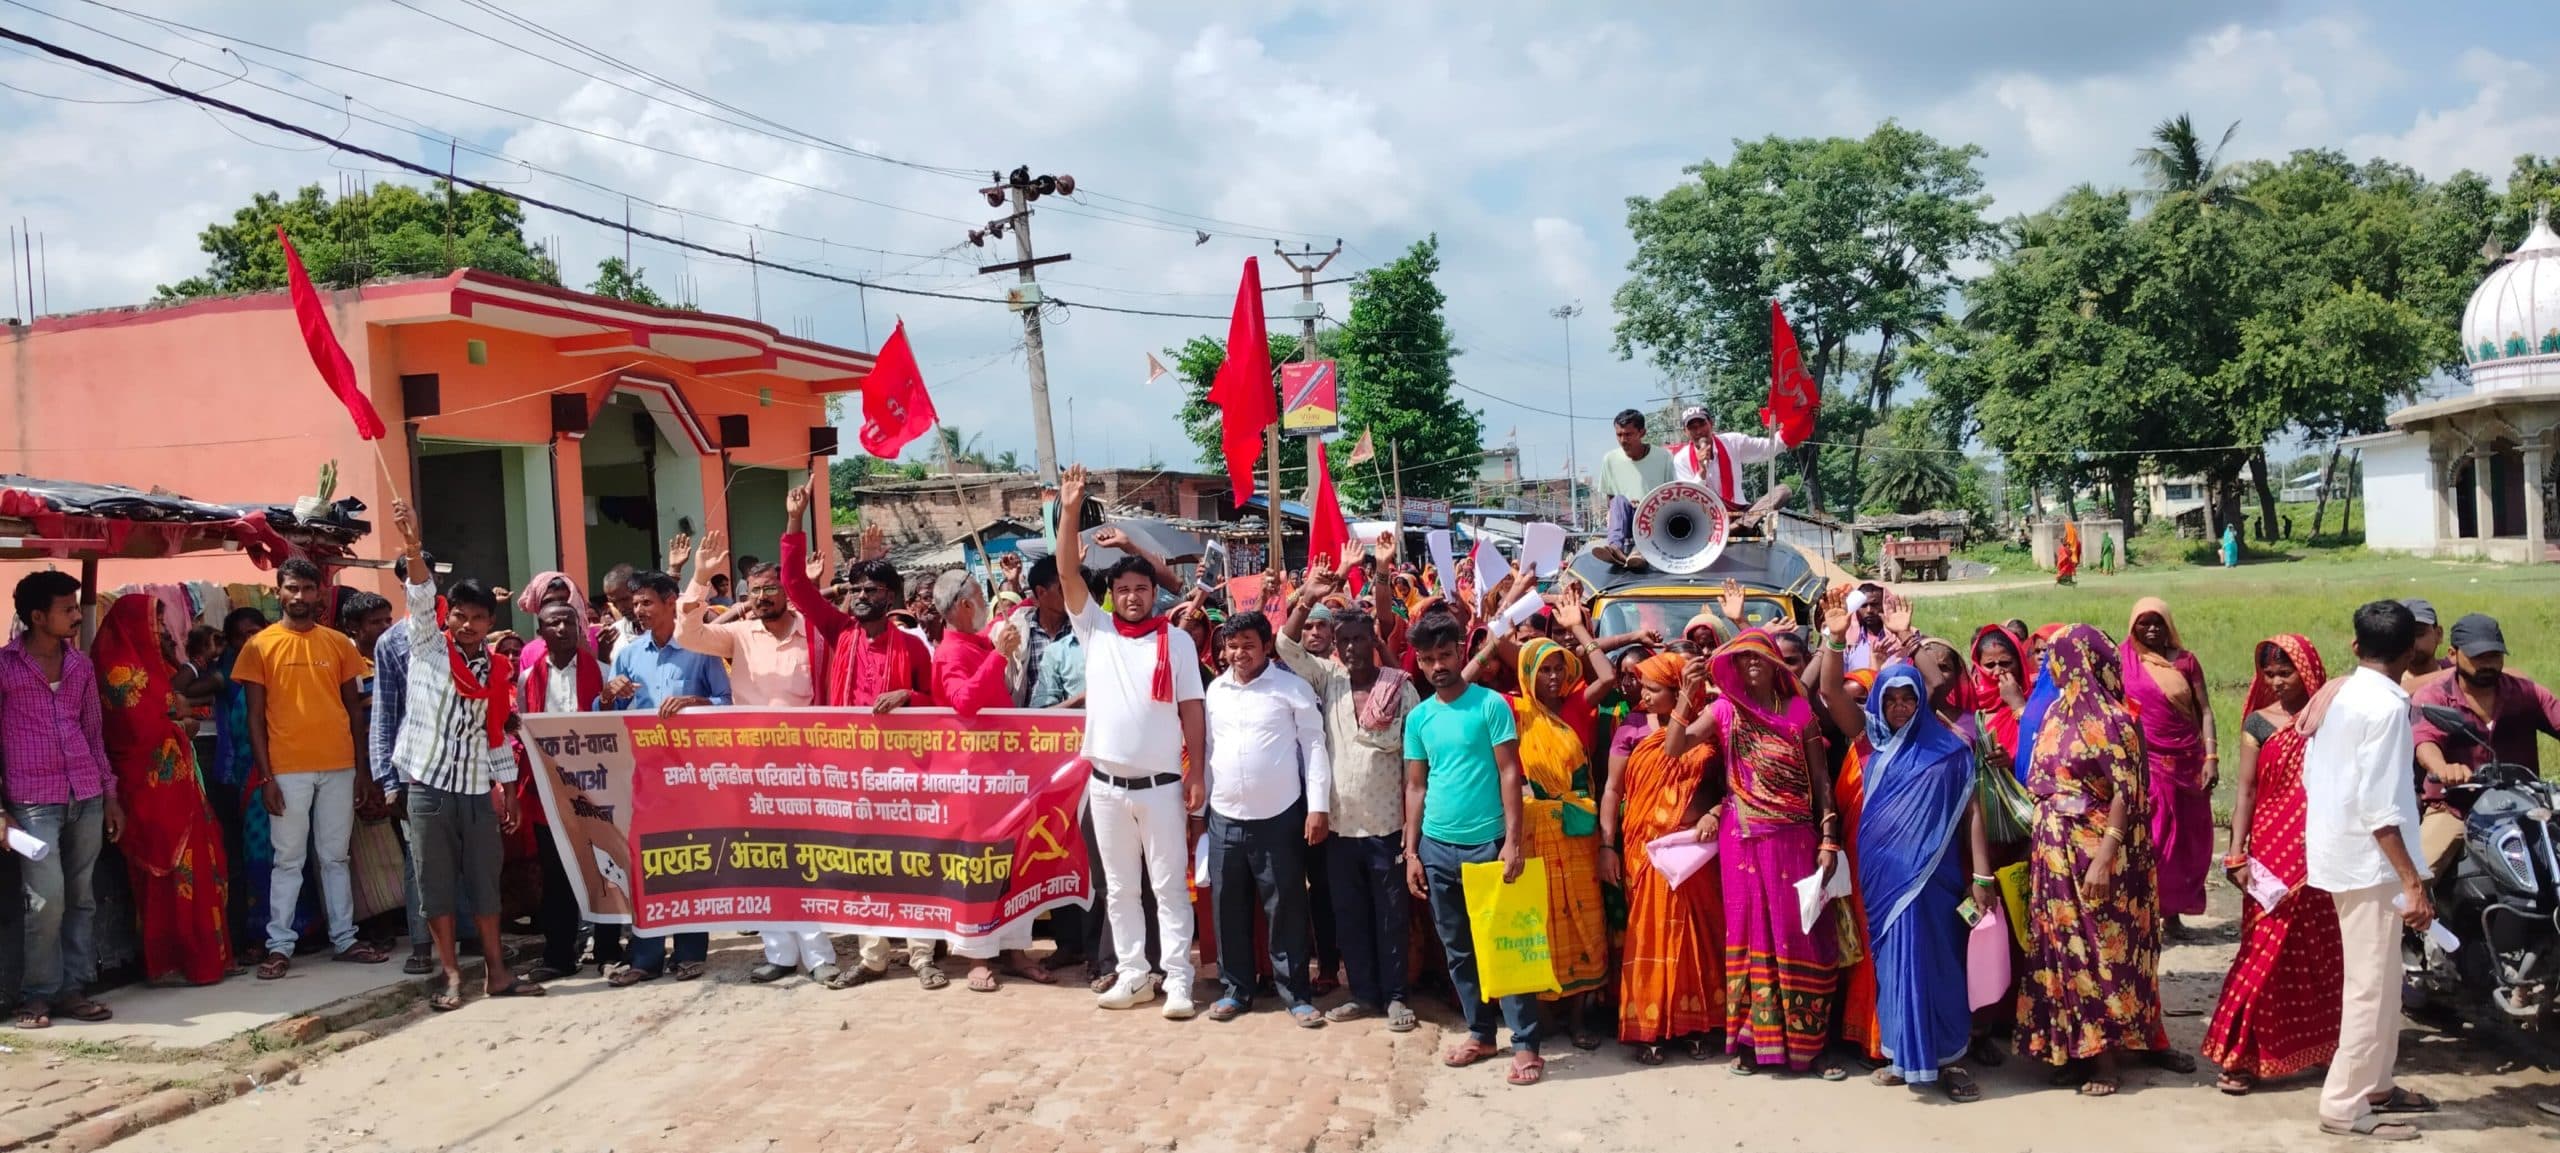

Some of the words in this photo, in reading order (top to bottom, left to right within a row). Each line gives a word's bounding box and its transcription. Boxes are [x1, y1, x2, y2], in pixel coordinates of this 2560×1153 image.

[632, 724, 669, 747] सभी
[671, 729, 691, 747] 95
[694, 728, 733, 747] लाख
[735, 722, 801, 747] महागरीब
[803, 722, 858, 749] परिवारों
[859, 724, 880, 750] को
[882, 730, 944, 757] एकमुश्त
[947, 730, 956, 751] 2
[959, 731, 1000, 752] लाख
[1029, 726, 1061, 752] देना
[663, 762, 697, 785] सभी
[699, 763, 753, 790] भूमिहीन
[755, 763, 807, 787] परिवारों
[807, 764, 822, 786] के
[823, 765, 849, 789] लिए
[851, 772, 859, 789] 5
[861, 767, 918, 792] डिसमिल
[921, 769, 981, 794] आवासीय
[984, 770, 1030, 794] जमीन
[749, 792, 775, 815] और
[776, 797, 812, 816] पक्का
[814, 799, 853, 819] मकान
[854, 797, 873, 820] की
[874, 799, 912, 821] गारंटी
[913, 799, 940, 824] करो
[794, 843, 894, 882] मुख्यालय
[900, 851, 933, 877] पर
[938, 847, 1014, 888] प्रदर्शन
[646, 899, 690, 922] 22-24
[693, 897, 735, 917] अगस्त
[737, 896, 771, 915] 2024
[1004, 870, 1081, 918] भाकपा-माले
[801, 898, 839, 916] सत्तर
[899, 903, 952, 923] सहरसा
